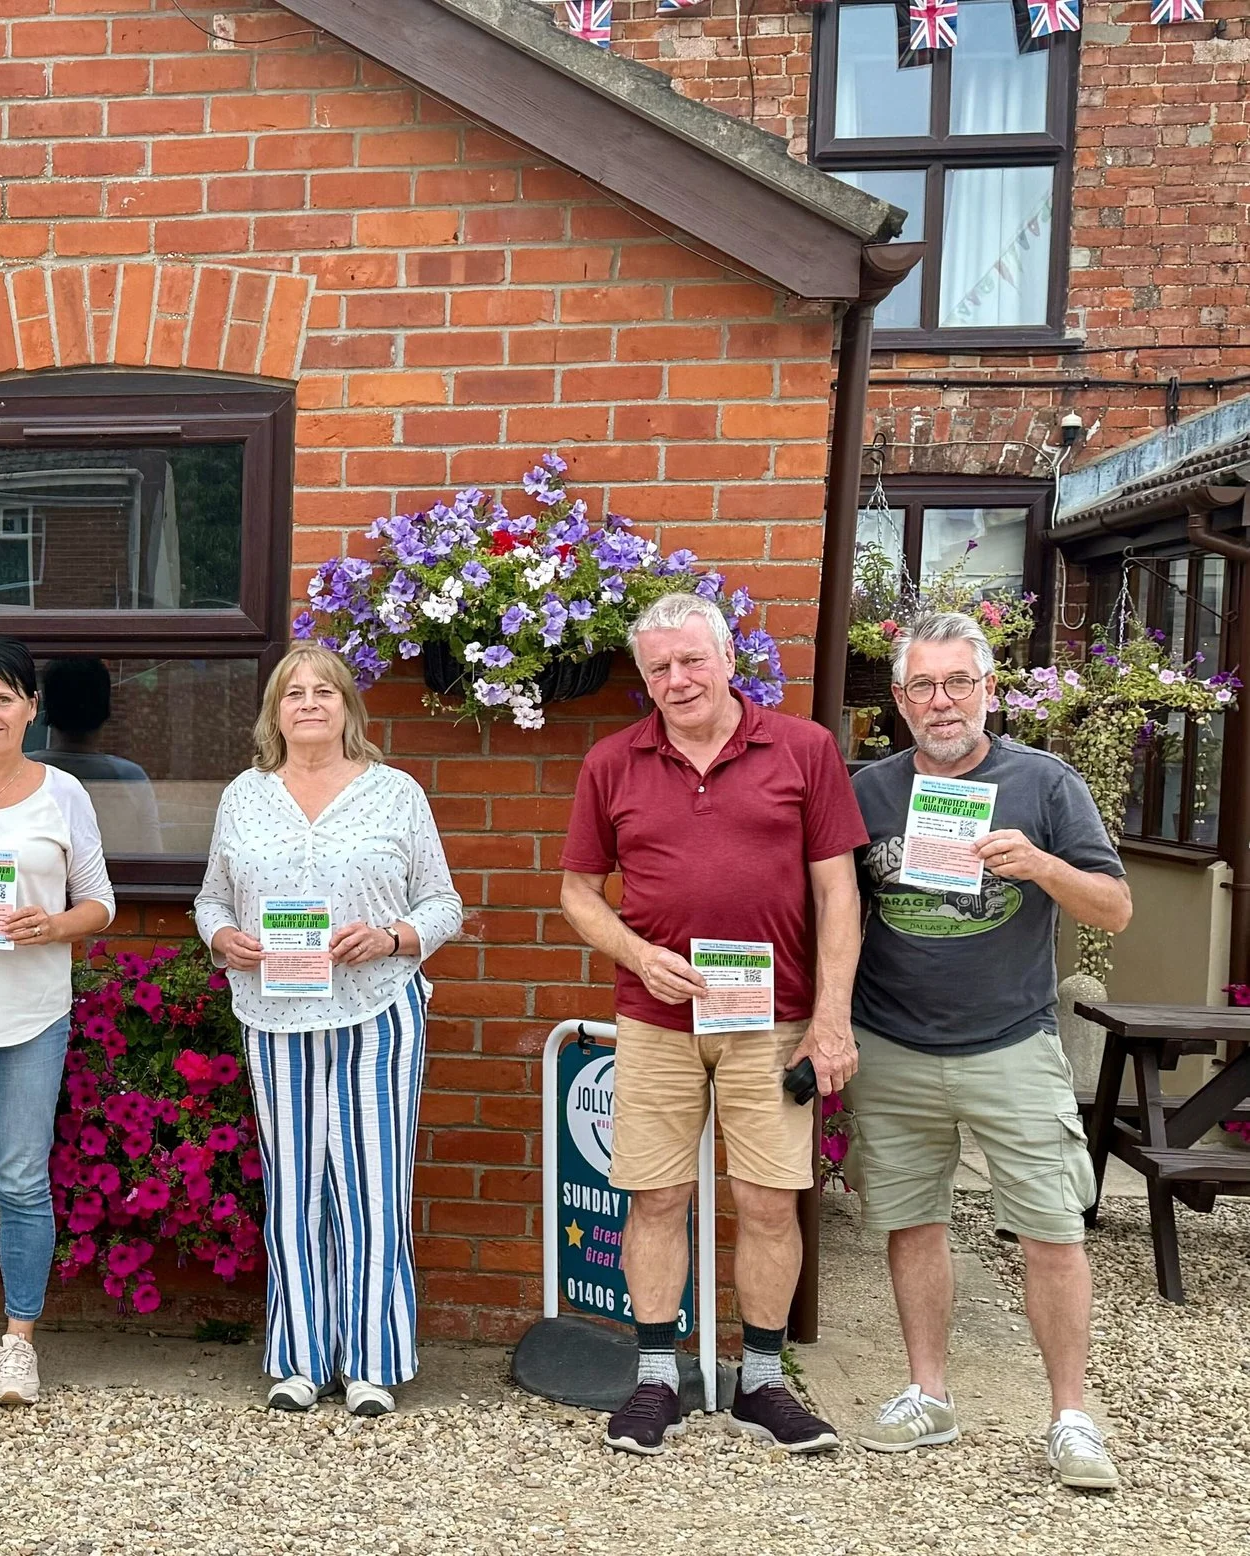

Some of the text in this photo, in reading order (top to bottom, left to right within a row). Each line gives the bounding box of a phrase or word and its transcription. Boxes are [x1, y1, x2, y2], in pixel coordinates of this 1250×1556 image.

[920, 795, 985, 810] HELP PROTECT OUR
[923, 804, 951, 813] QUALITY
[963, 809, 977, 817] LIFE
[881, 896, 936, 908] ARAGE
[910, 922, 942, 931] DALLAS
[575, 1085, 614, 1116] JOLLY
[562, 1181, 620, 1218] SUNDAY
[592, 1225, 623, 1246] Great
[585, 1246, 614, 1268] Great
[567, 1277, 615, 1312] 01406
